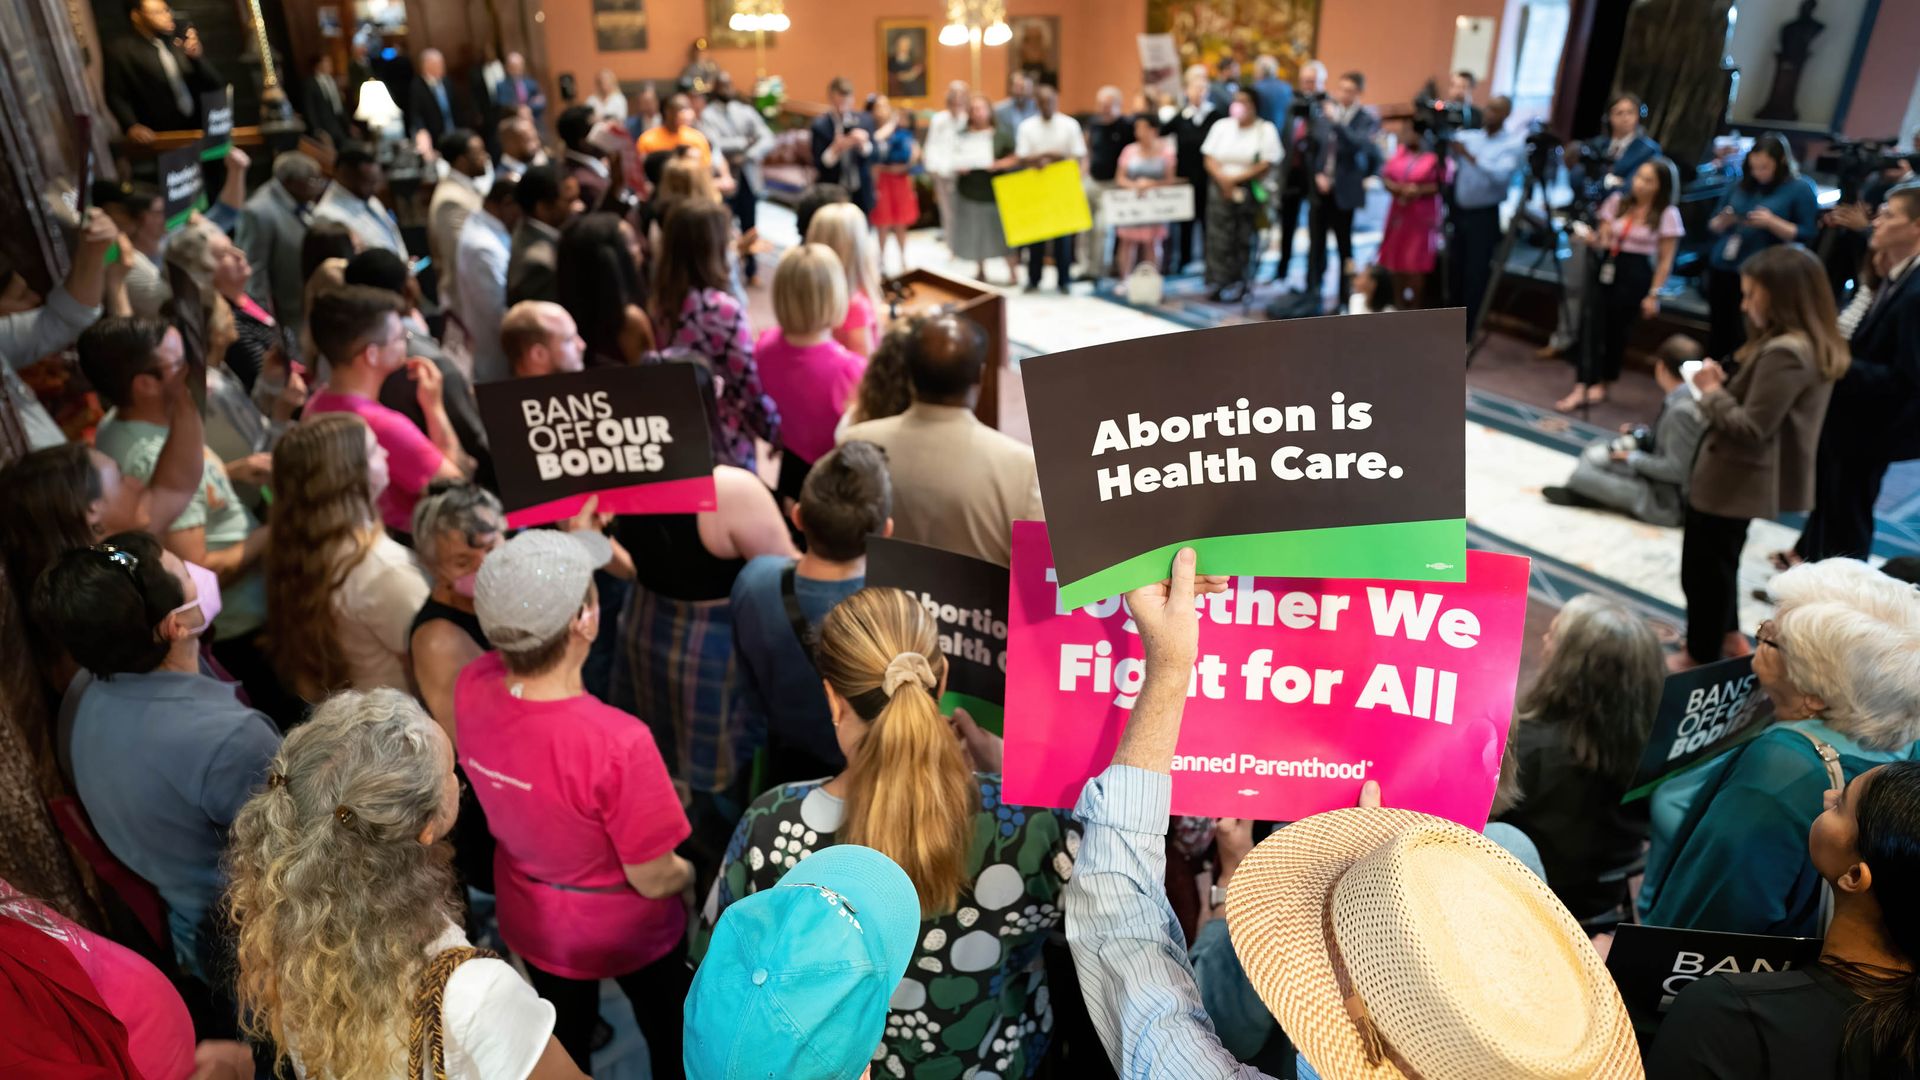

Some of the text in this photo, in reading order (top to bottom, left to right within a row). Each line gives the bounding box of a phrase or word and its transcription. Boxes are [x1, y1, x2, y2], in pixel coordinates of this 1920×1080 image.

[521, 390, 613, 427] BANS
[1091, 391, 1373, 457] Abortion is
[528, 415, 673, 454] OFF OUR
[536, 443, 665, 481] BODIES
[1096, 445, 1404, 502] Health Care.
[904, 590, 1008, 641] bortio
[1366, 586, 1481, 649] We
[938, 631, 992, 667] alth
[1059, 640, 1227, 711] Figt
[1240, 648, 1344, 705] for
[1354, 663, 1458, 725] All
[1685, 673, 1757, 715] BANS
[1676, 702, 1730, 738] OFF
[1170, 753, 1236, 773] anned
[1672, 951, 1792, 976] BAN
